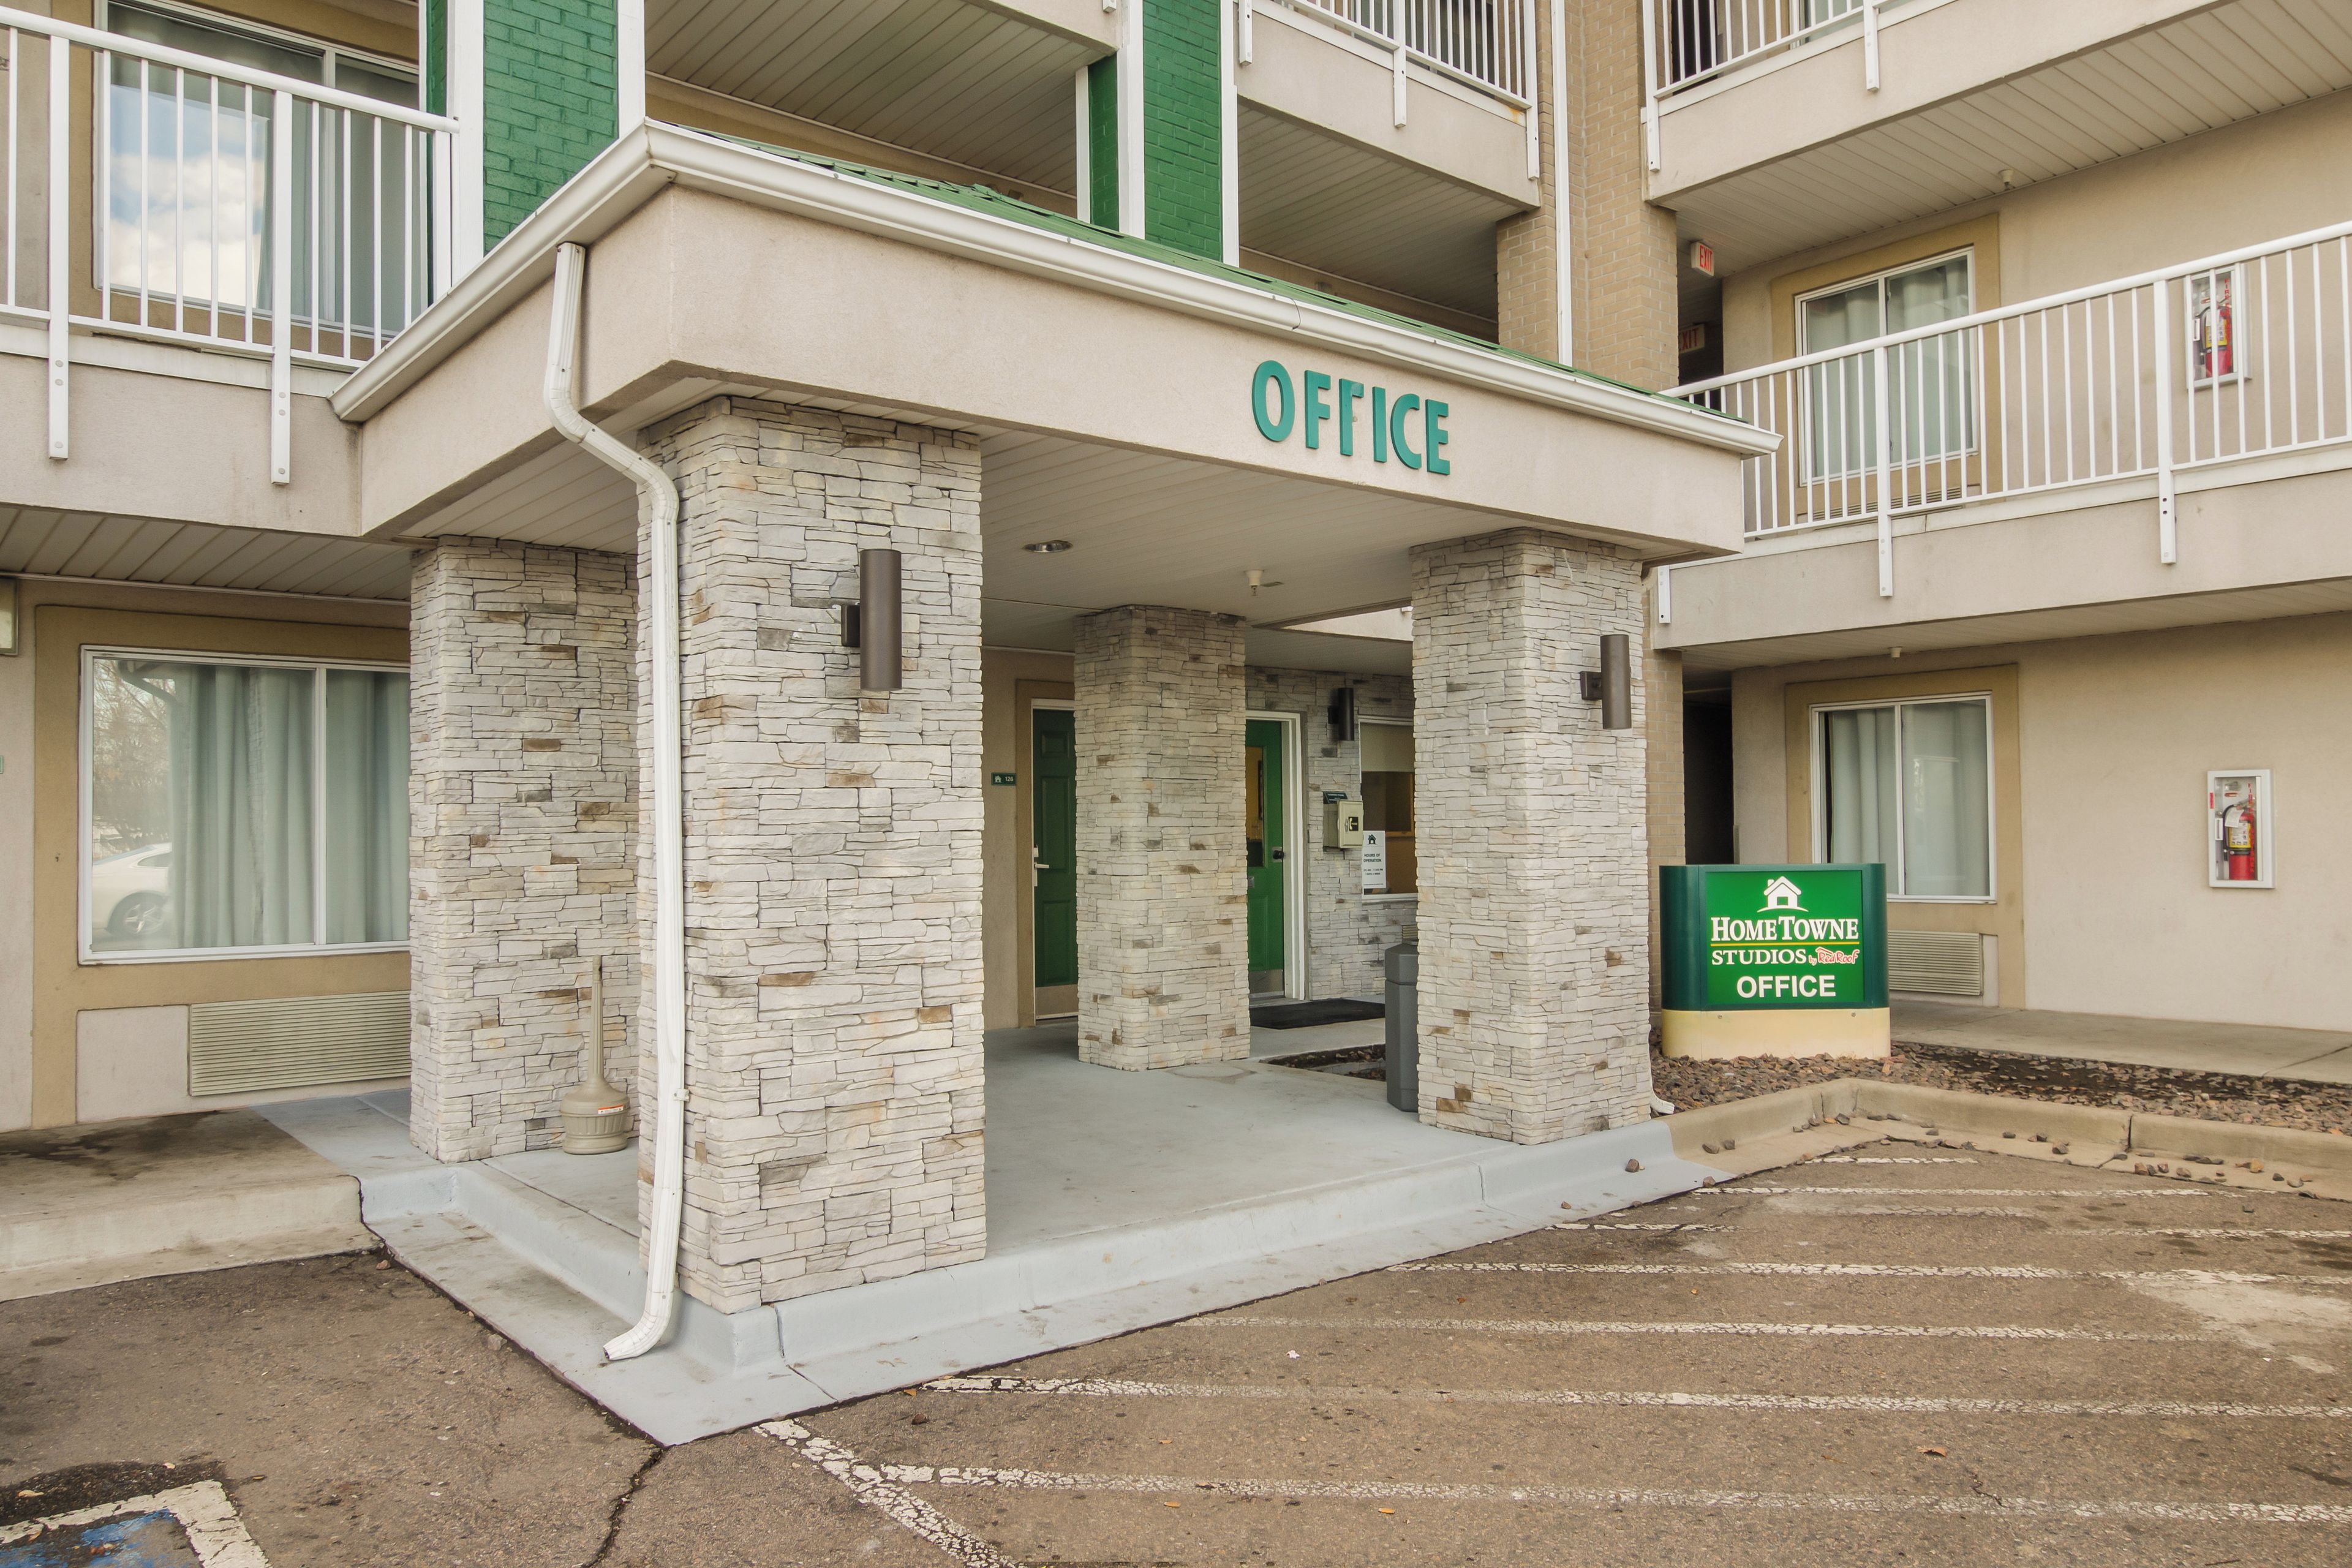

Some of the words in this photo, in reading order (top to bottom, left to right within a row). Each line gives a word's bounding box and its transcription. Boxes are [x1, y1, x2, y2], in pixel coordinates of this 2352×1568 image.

[1699, 245, 1713, 272] EXIT
[1252, 360, 1450, 475] OFFICE
[1712, 949, 1807, 965] STUDIOS
[1736, 974, 1836, 998] OFFICE
